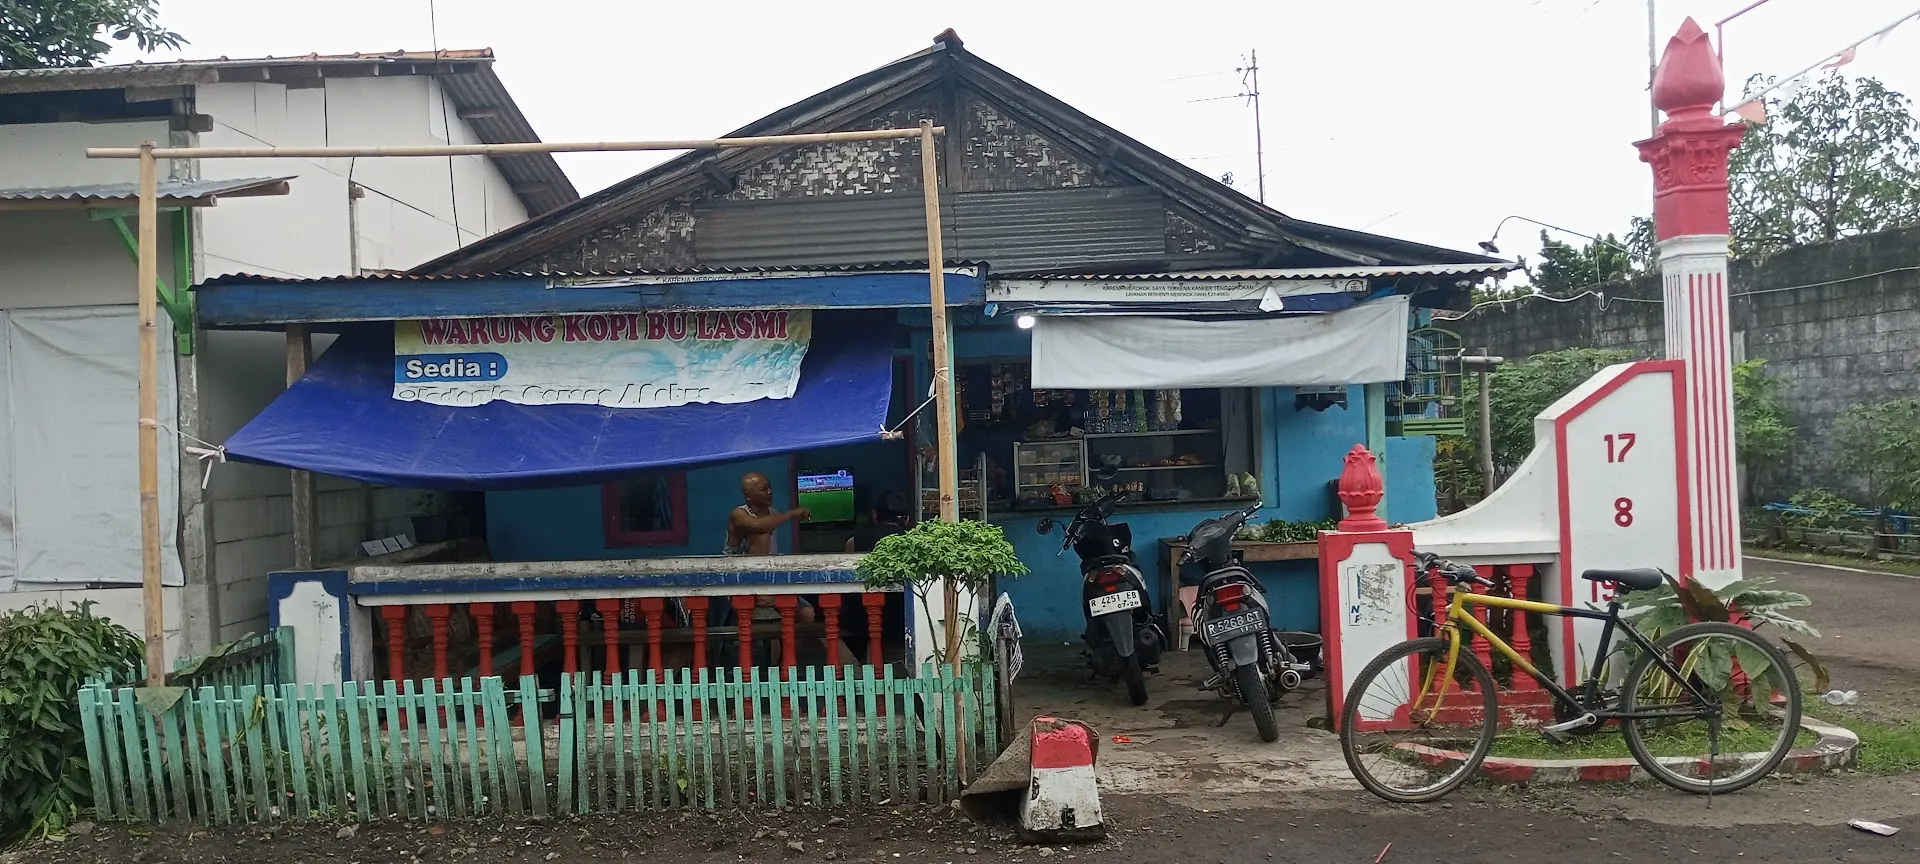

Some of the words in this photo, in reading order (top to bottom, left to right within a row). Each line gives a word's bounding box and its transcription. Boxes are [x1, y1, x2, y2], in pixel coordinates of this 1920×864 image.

[420, 316, 556, 345] WARUNG
[563, 313, 639, 343] KOPI
[645, 311, 688, 341] BU
[694, 310, 789, 340] LASMI
[406, 358, 481, 379] Sedia
[1603, 433, 1636, 463] 17
[1614, 497, 1633, 527] 8
[1102, 594, 1121, 604] 4251
[1588, 579, 1617, 603] 19
[1208, 624, 1216, 634] R
[1217, 616, 1244, 631] 5268
[1246, 610, 1260, 622] GT
